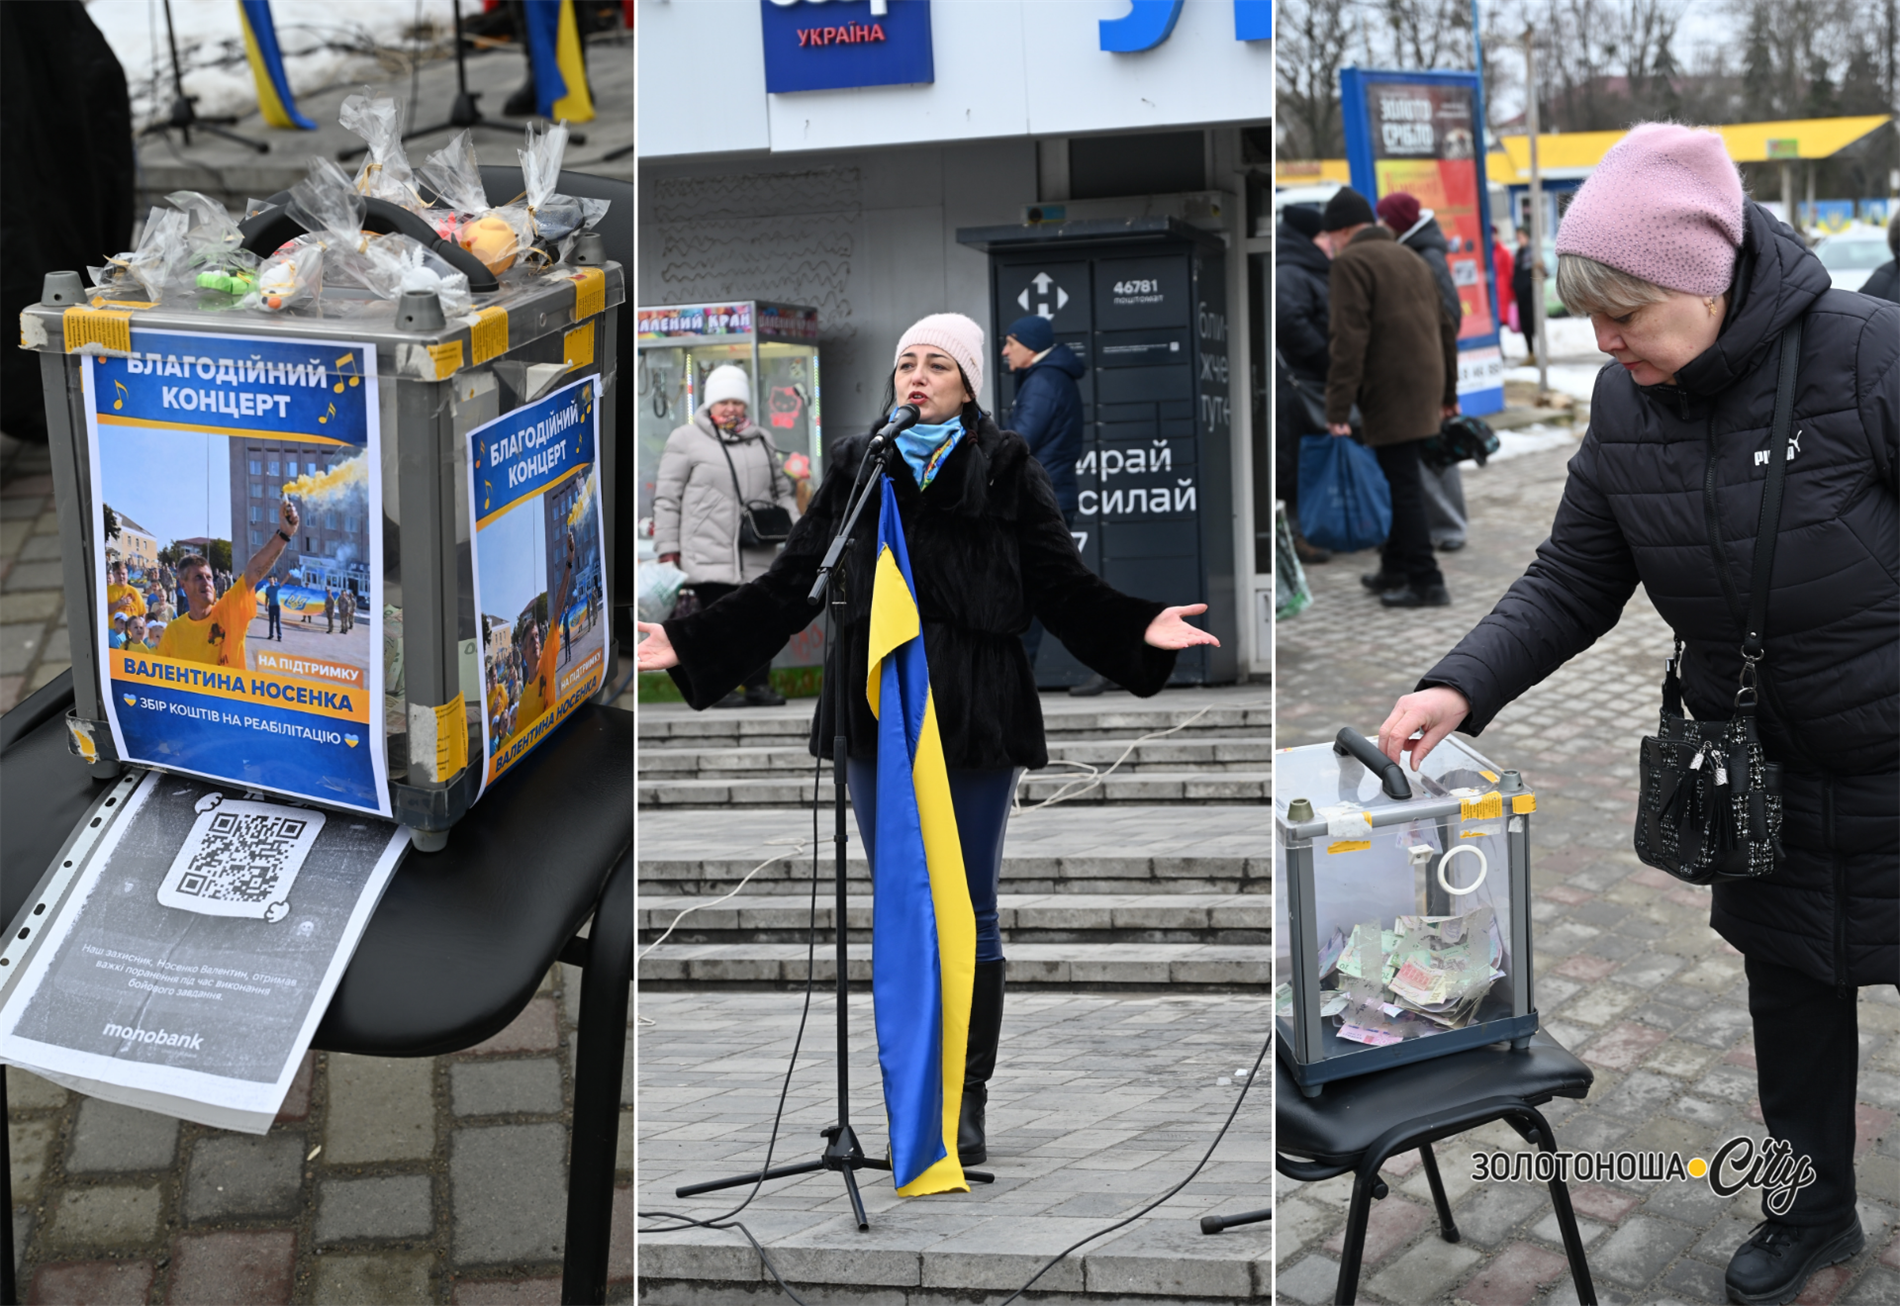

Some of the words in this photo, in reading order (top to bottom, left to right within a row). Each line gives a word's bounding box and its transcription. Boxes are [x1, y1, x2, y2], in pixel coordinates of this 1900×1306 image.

[797, 21, 886, 47] УКРАЇНА
[1113, 279, 1158, 295] 46781
[638, 313, 703, 333] АЛЕНИЙ
[707, 312, 750, 329] КРАН
[127, 351, 328, 389] БЛАГОДІЙНИЙ
[162, 385, 292, 418] КОНЦЕРТ
[490, 399, 579, 468] БЛАГОДІЙНИЙ
[508, 439, 567, 489] КОНЦЕРТ
[1075, 438, 1172, 482] ирай
[1078, 477, 1197, 516] силай
[123, 657, 247, 695] ВАЛЕНТИНА
[251, 680, 354, 712] НОСЕНКА
[258, 654, 277, 668] НА
[278, 658, 359, 682] ПІДТРИМКУ
[140, 697, 168, 712] ЗБІР
[169, 702, 220, 723] КОШТІВ
[222, 713, 242, 728] НА
[244, 716, 342, 745] РЕАБІЛІТАЦІЮ
[495, 711, 555, 773] ВАЛЕНТИНА
[555, 675, 597, 721] НОСЕНКА
[81, 943, 105, 956] Наш
[105, 949, 154, 968] захисник,
[156, 958, 199, 975] Носенко
[200, 964, 249, 981] Валентин,
[252, 973, 298, 988] отримав
[95, 959, 125, 973] важкі
[125, 965, 180, 984] поранення
[180, 974, 195, 987] під
[197, 977, 215, 988] час
[215, 979, 272, 997] виконання
[128, 977, 175, 997] бойового
[176, 987, 224, 1002] завдання.
[102, 1021, 205, 1051] monobank
